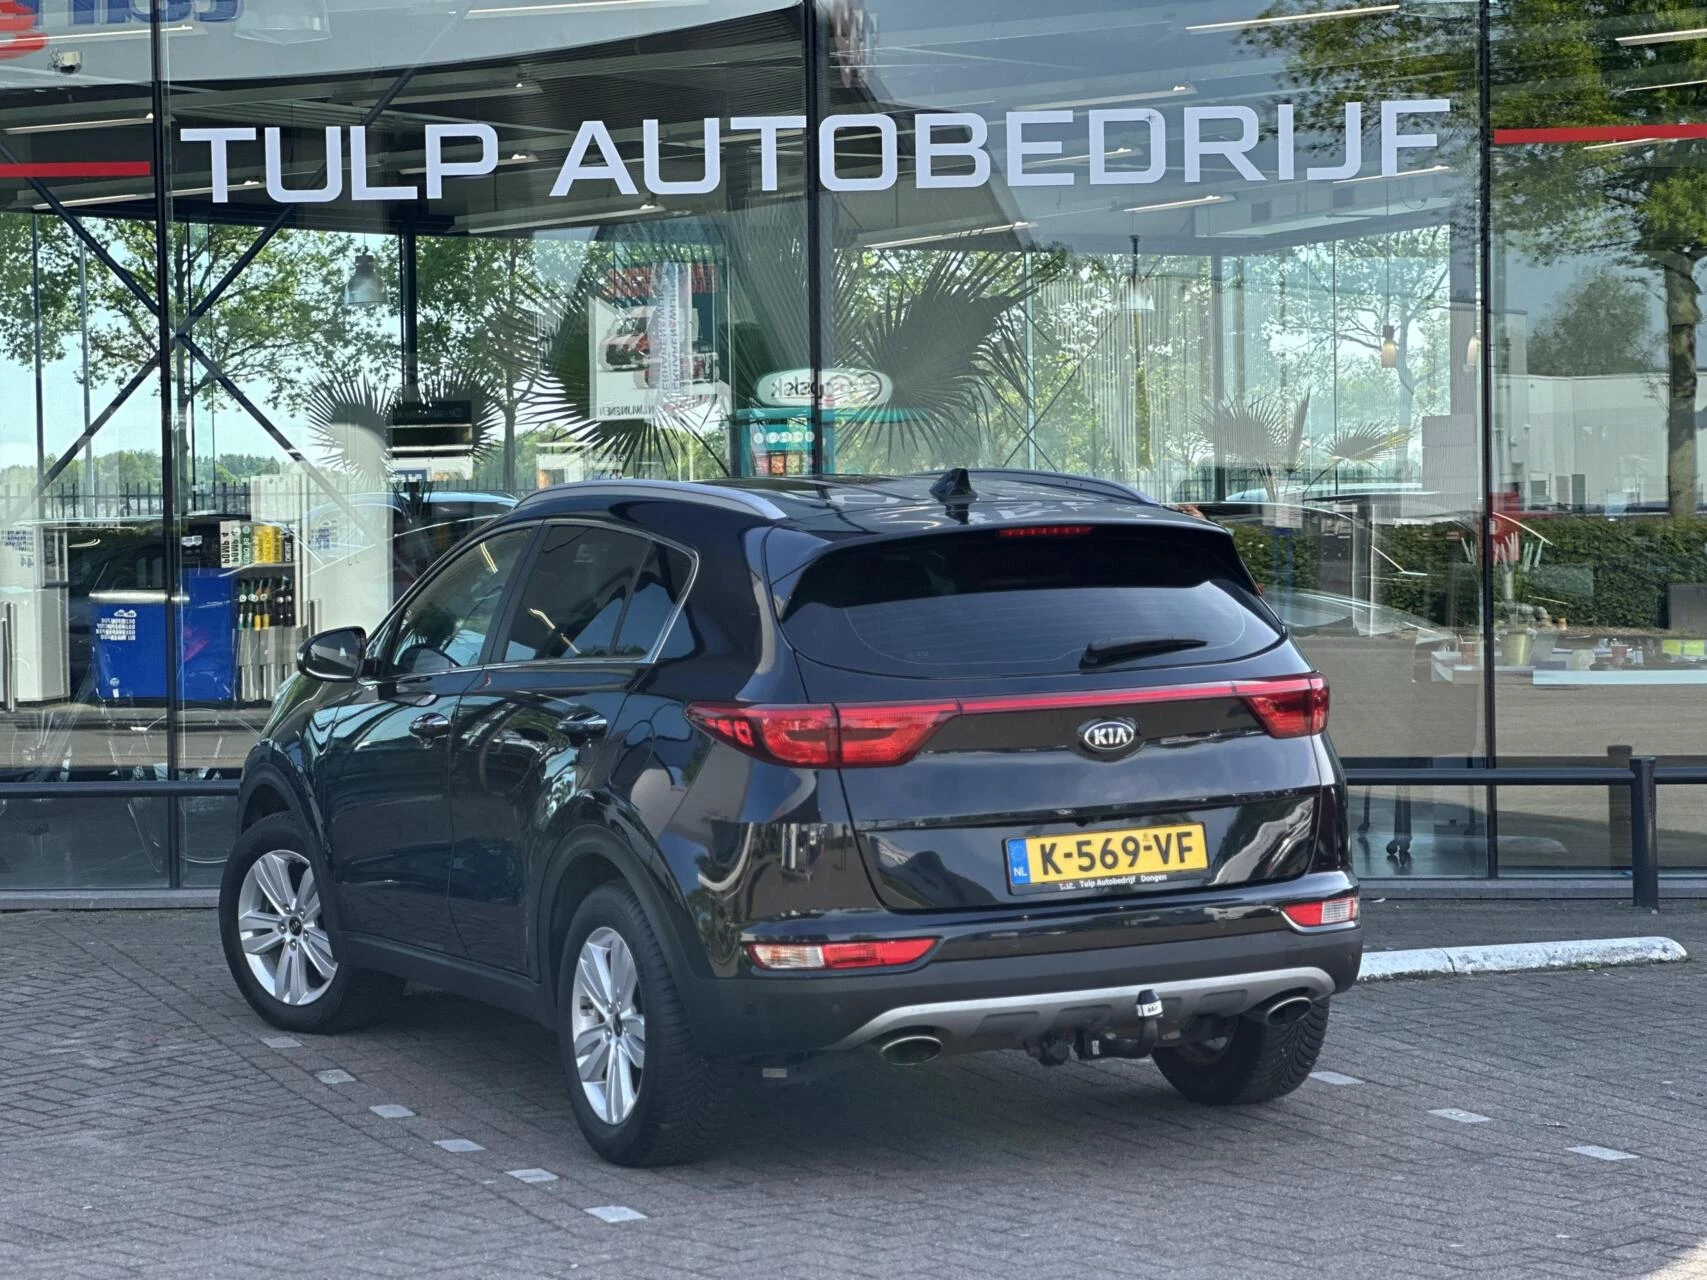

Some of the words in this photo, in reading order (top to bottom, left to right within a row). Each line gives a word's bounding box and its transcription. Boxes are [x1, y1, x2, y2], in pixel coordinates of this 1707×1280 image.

[180, 123, 498, 203] TULP
[549, 98, 1451, 197] AUTOBEDRIJF
[1094, 727, 1128, 745] KIA
[1040, 831, 1193, 876] K-569-VF
[1013, 867, 1027, 878] NL
[1079, 880, 1095, 888] Tulp
[1096, 876, 1136, 887] Autobedrijf
[1140, 874, 1167, 884] Dongen
